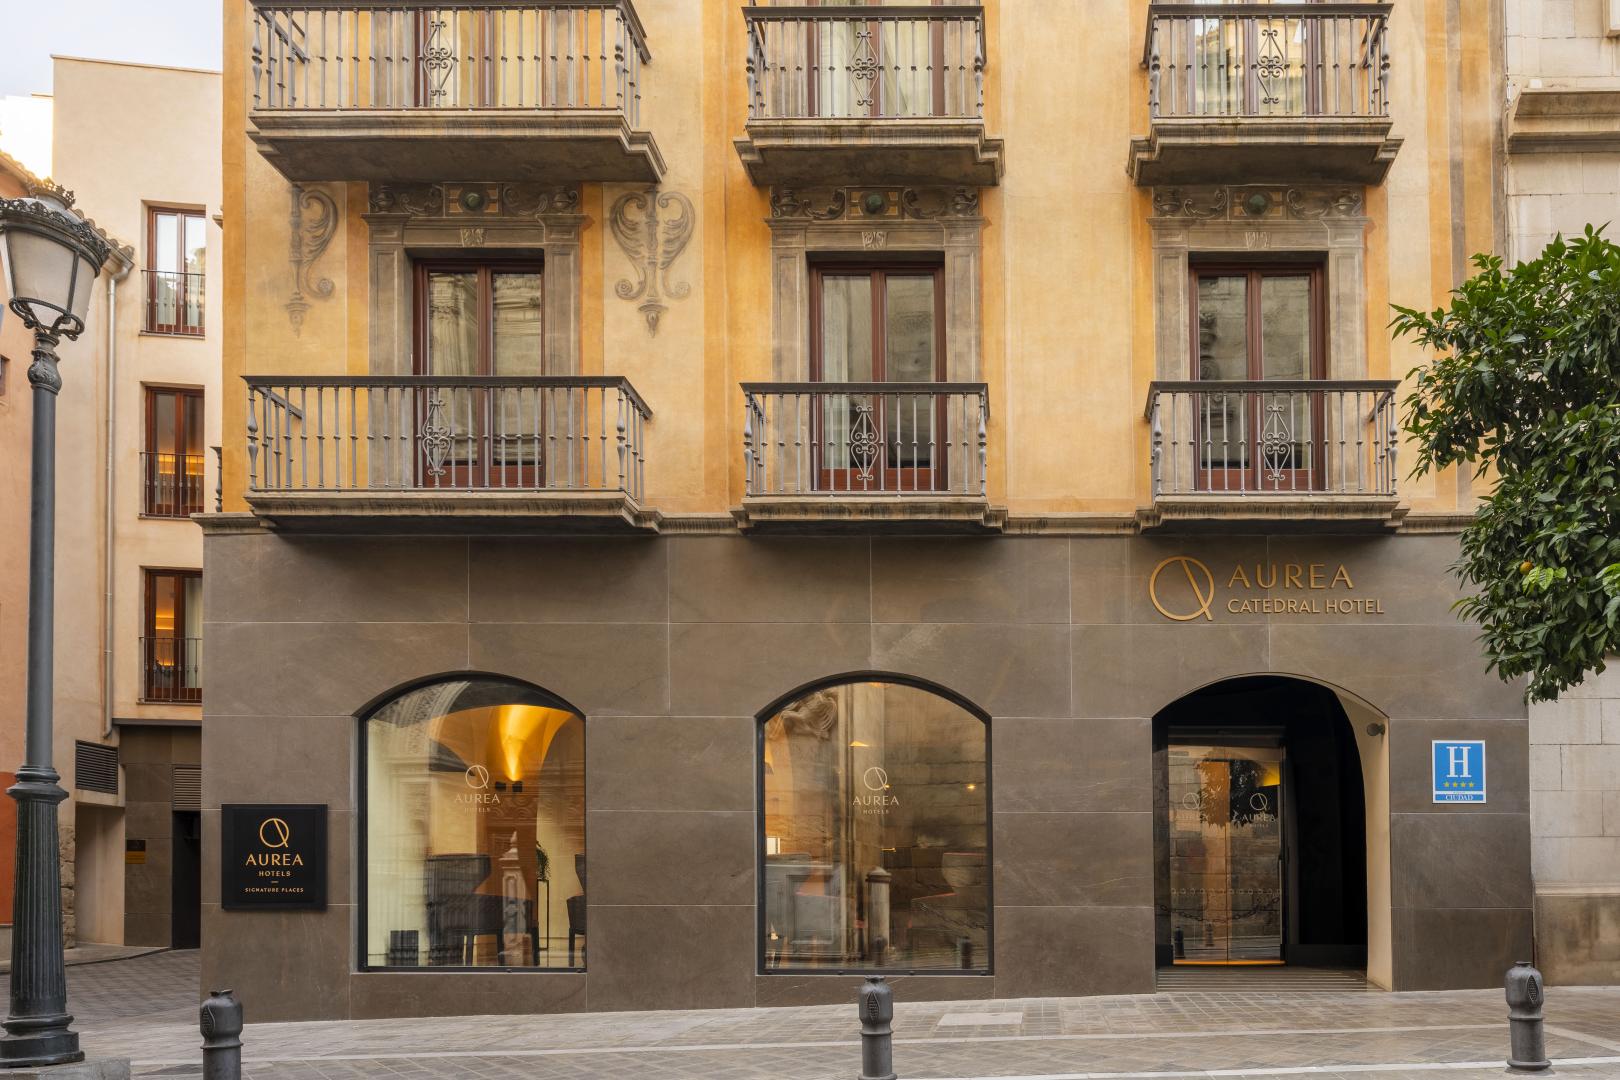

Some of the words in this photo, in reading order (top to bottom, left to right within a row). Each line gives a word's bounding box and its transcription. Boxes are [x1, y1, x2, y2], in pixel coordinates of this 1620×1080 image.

[1228, 564, 1354, 589] AUREA
[1227, 599, 1320, 614] CATEDRAL
[1326, 599, 1384, 614] HOTEL
[1446, 746, 1472, 778] H
[454, 793, 501, 804] AUREA
[852, 795, 900, 806] AUREA
[245, 853, 304, 866] AUREA
